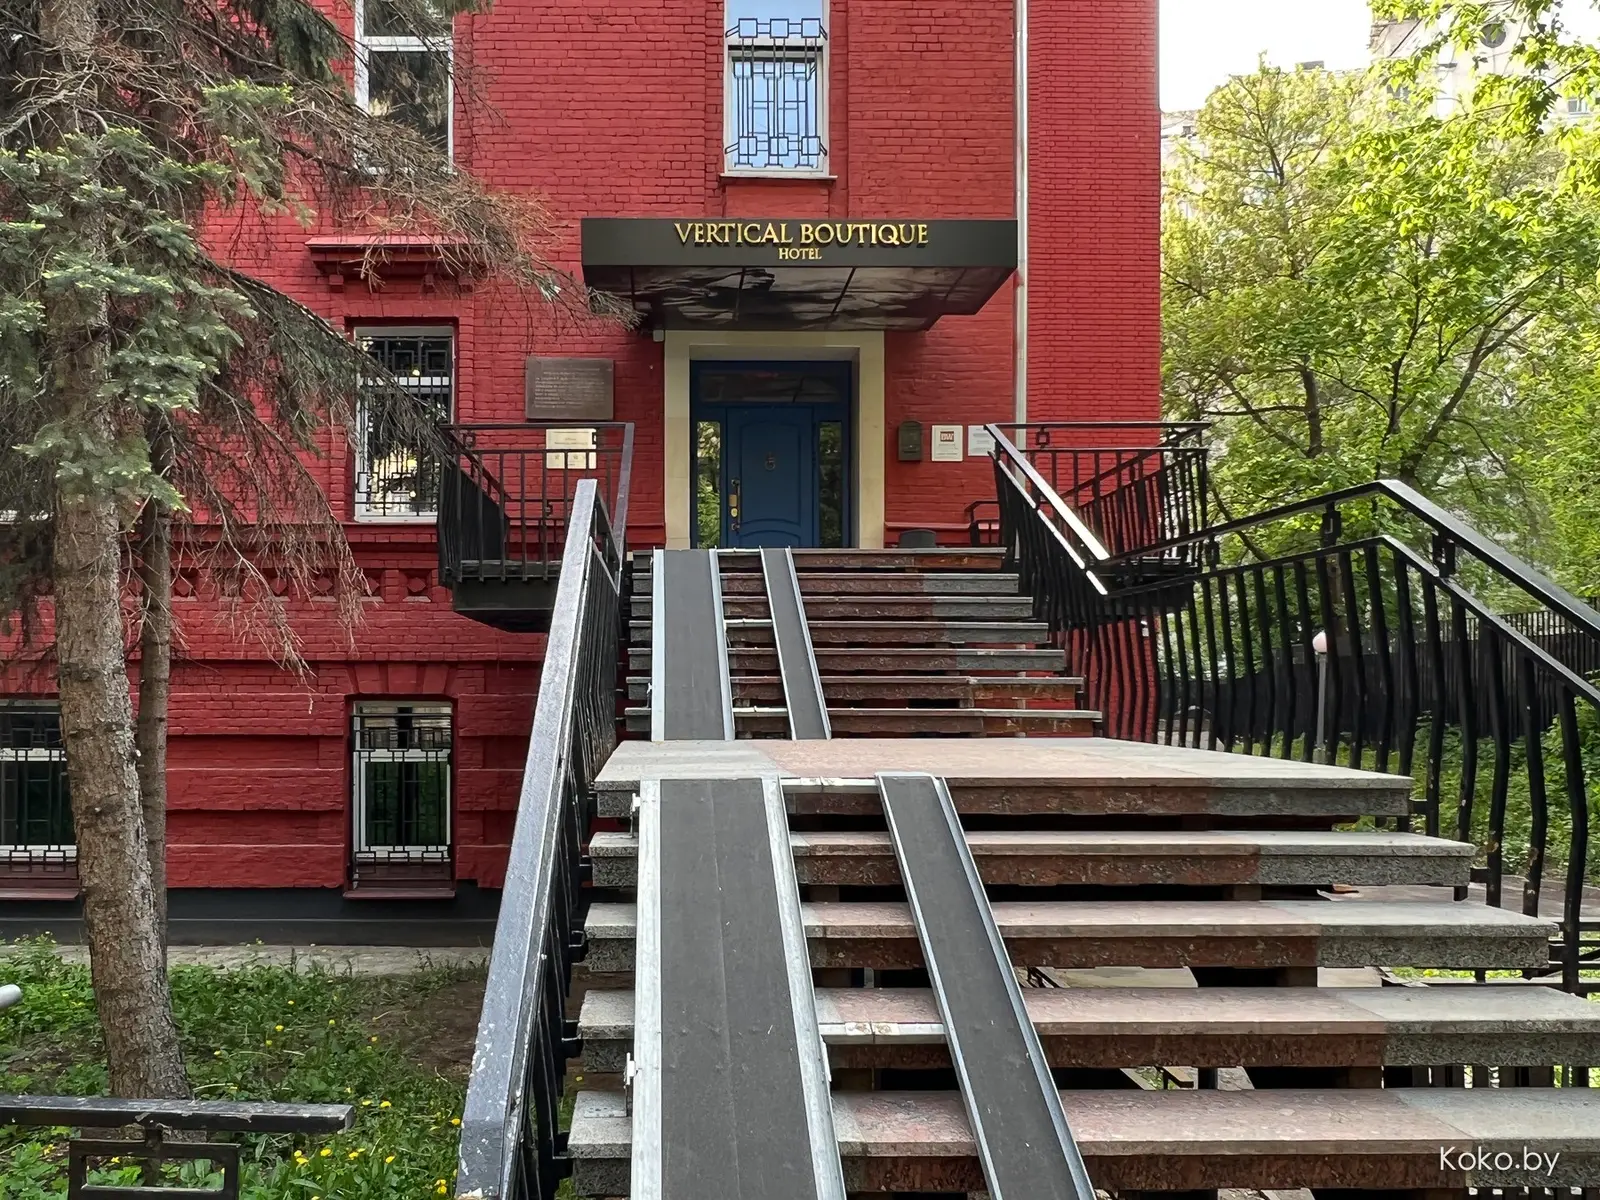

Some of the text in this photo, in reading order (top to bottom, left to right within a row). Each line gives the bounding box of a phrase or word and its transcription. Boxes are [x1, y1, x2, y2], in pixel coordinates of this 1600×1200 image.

[674, 222, 929, 246] VERTICAL BOUTIQUE
[778, 247, 822, 260] HOTEL
